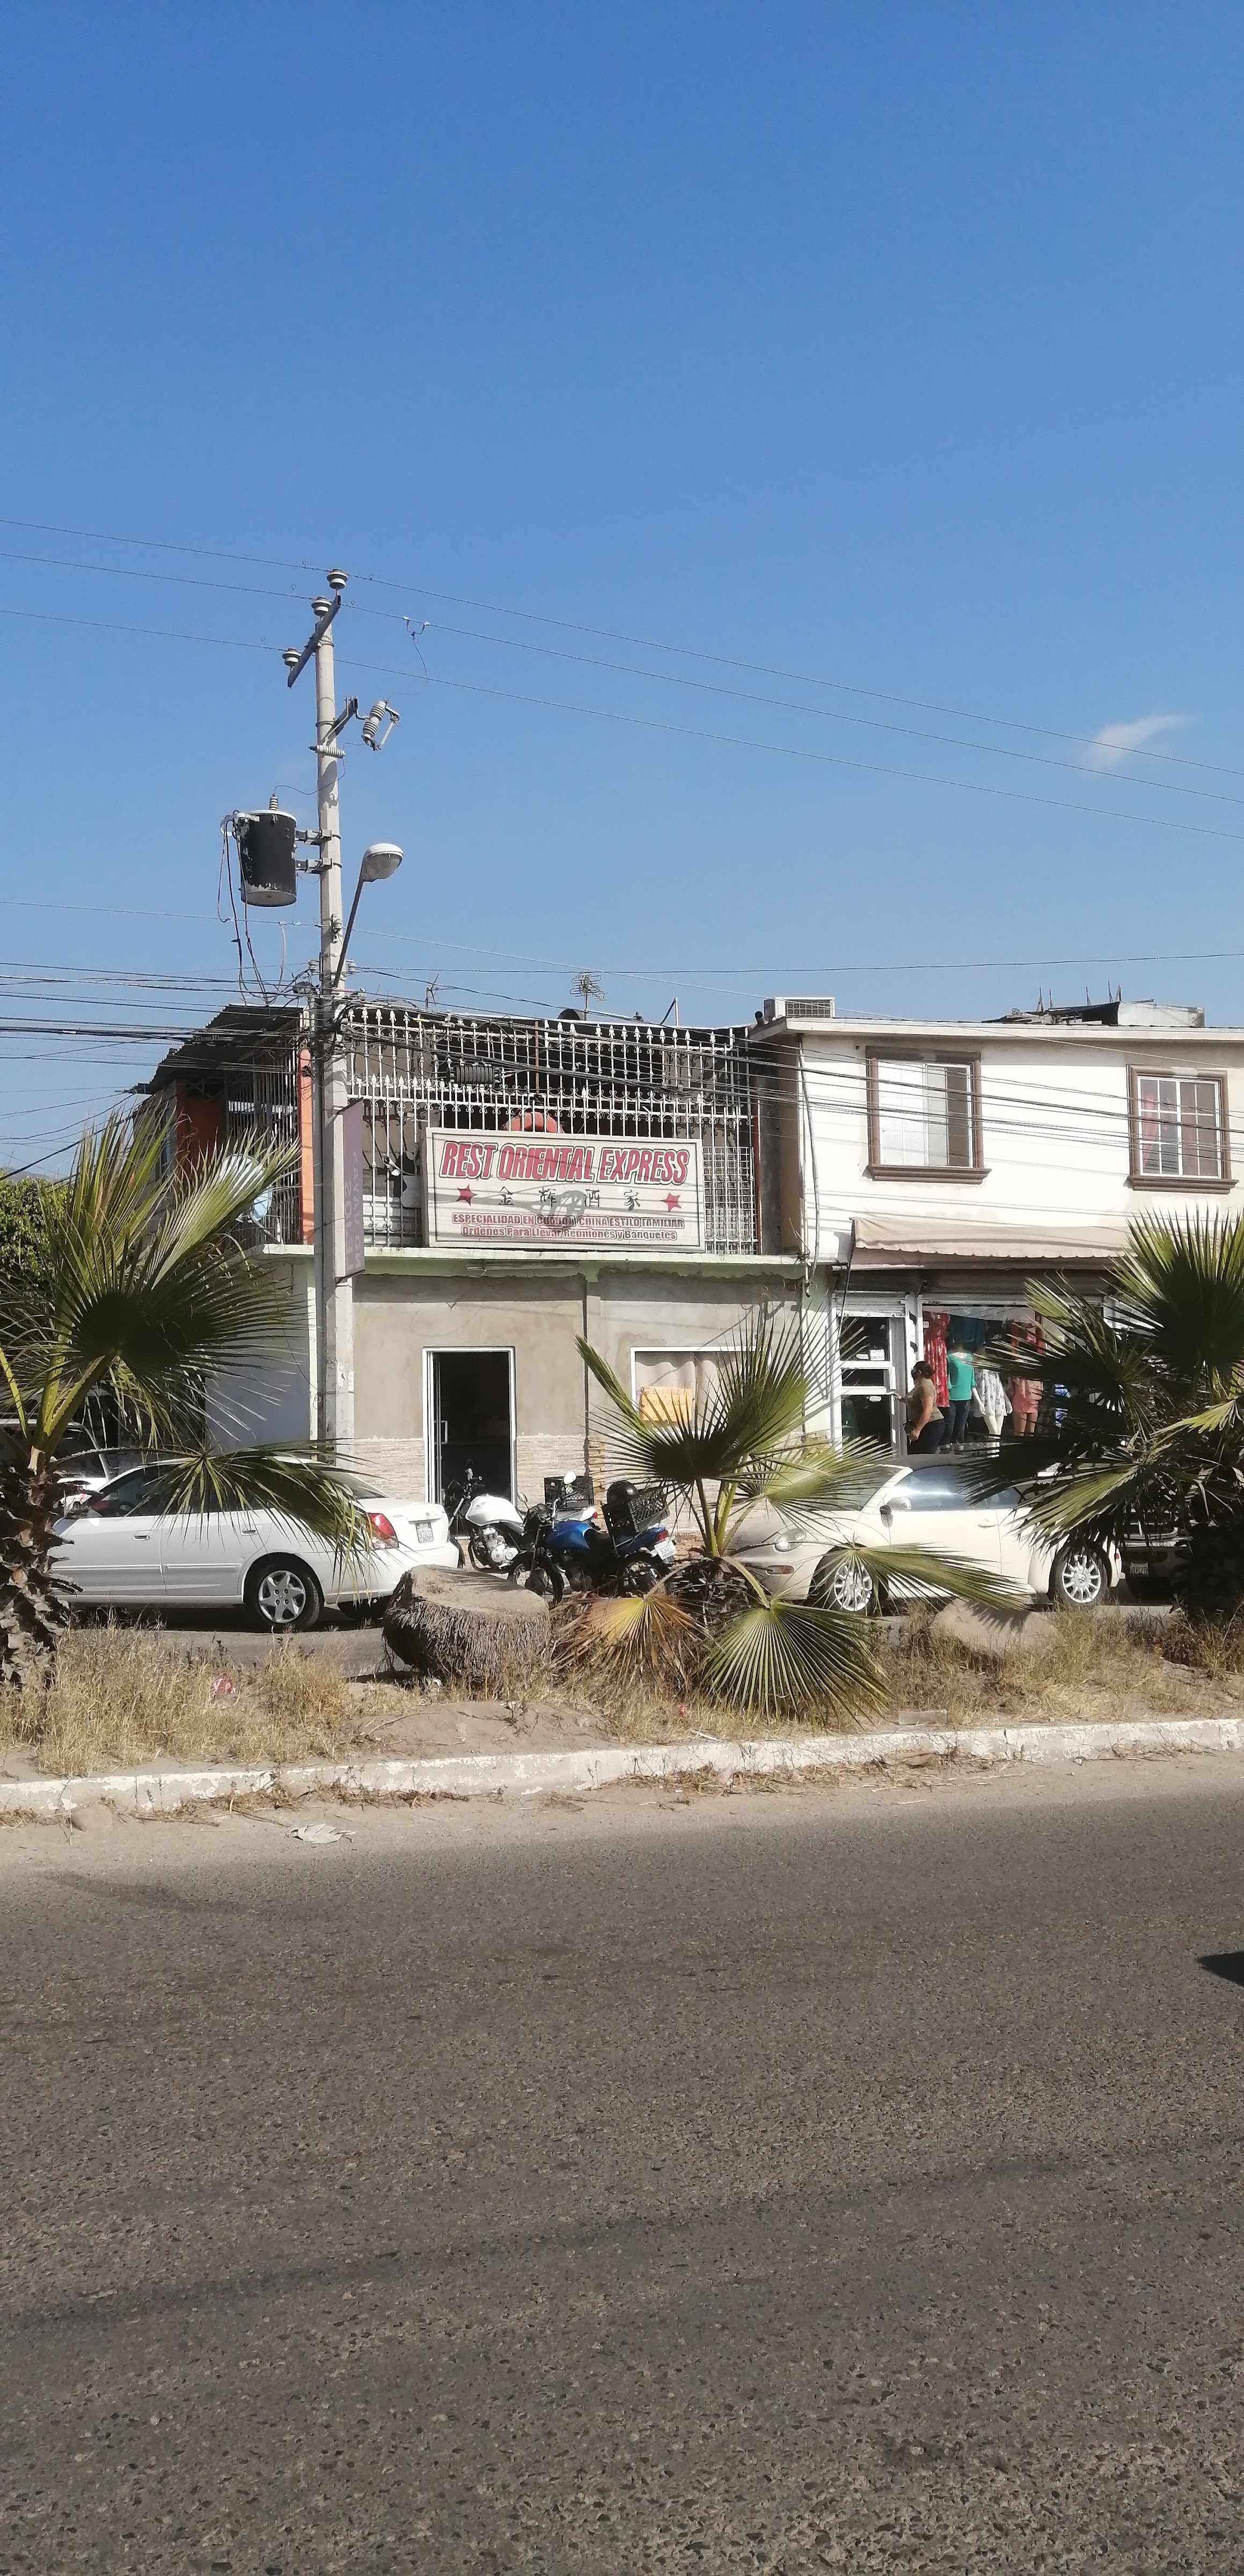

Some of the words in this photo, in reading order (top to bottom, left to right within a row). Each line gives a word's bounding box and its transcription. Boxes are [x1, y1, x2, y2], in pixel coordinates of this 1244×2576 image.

[441, 1142, 497, 1179] REST
[499, 1145, 595, 1181] ORIENTAL
[598, 1148, 689, 1184] EXPRESS
[452, 1213, 521, 1224] ESPECIALIDAD
[523, 1215, 535, 1225] EN
[537, 1215, 575, 1226] COMIDA
[579, 1217, 608, 1227] CHINA
[609, 1218, 641, 1227] ESTILO
[642, 1218, 684, 1228] FAMILIAR
[507, 1226, 530, 1238] Para
[532, 1227, 561, 1238] Llevar
[564, 1228, 616, 1239] Reuniones
[625, 1230, 677, 1241] Banquetes
